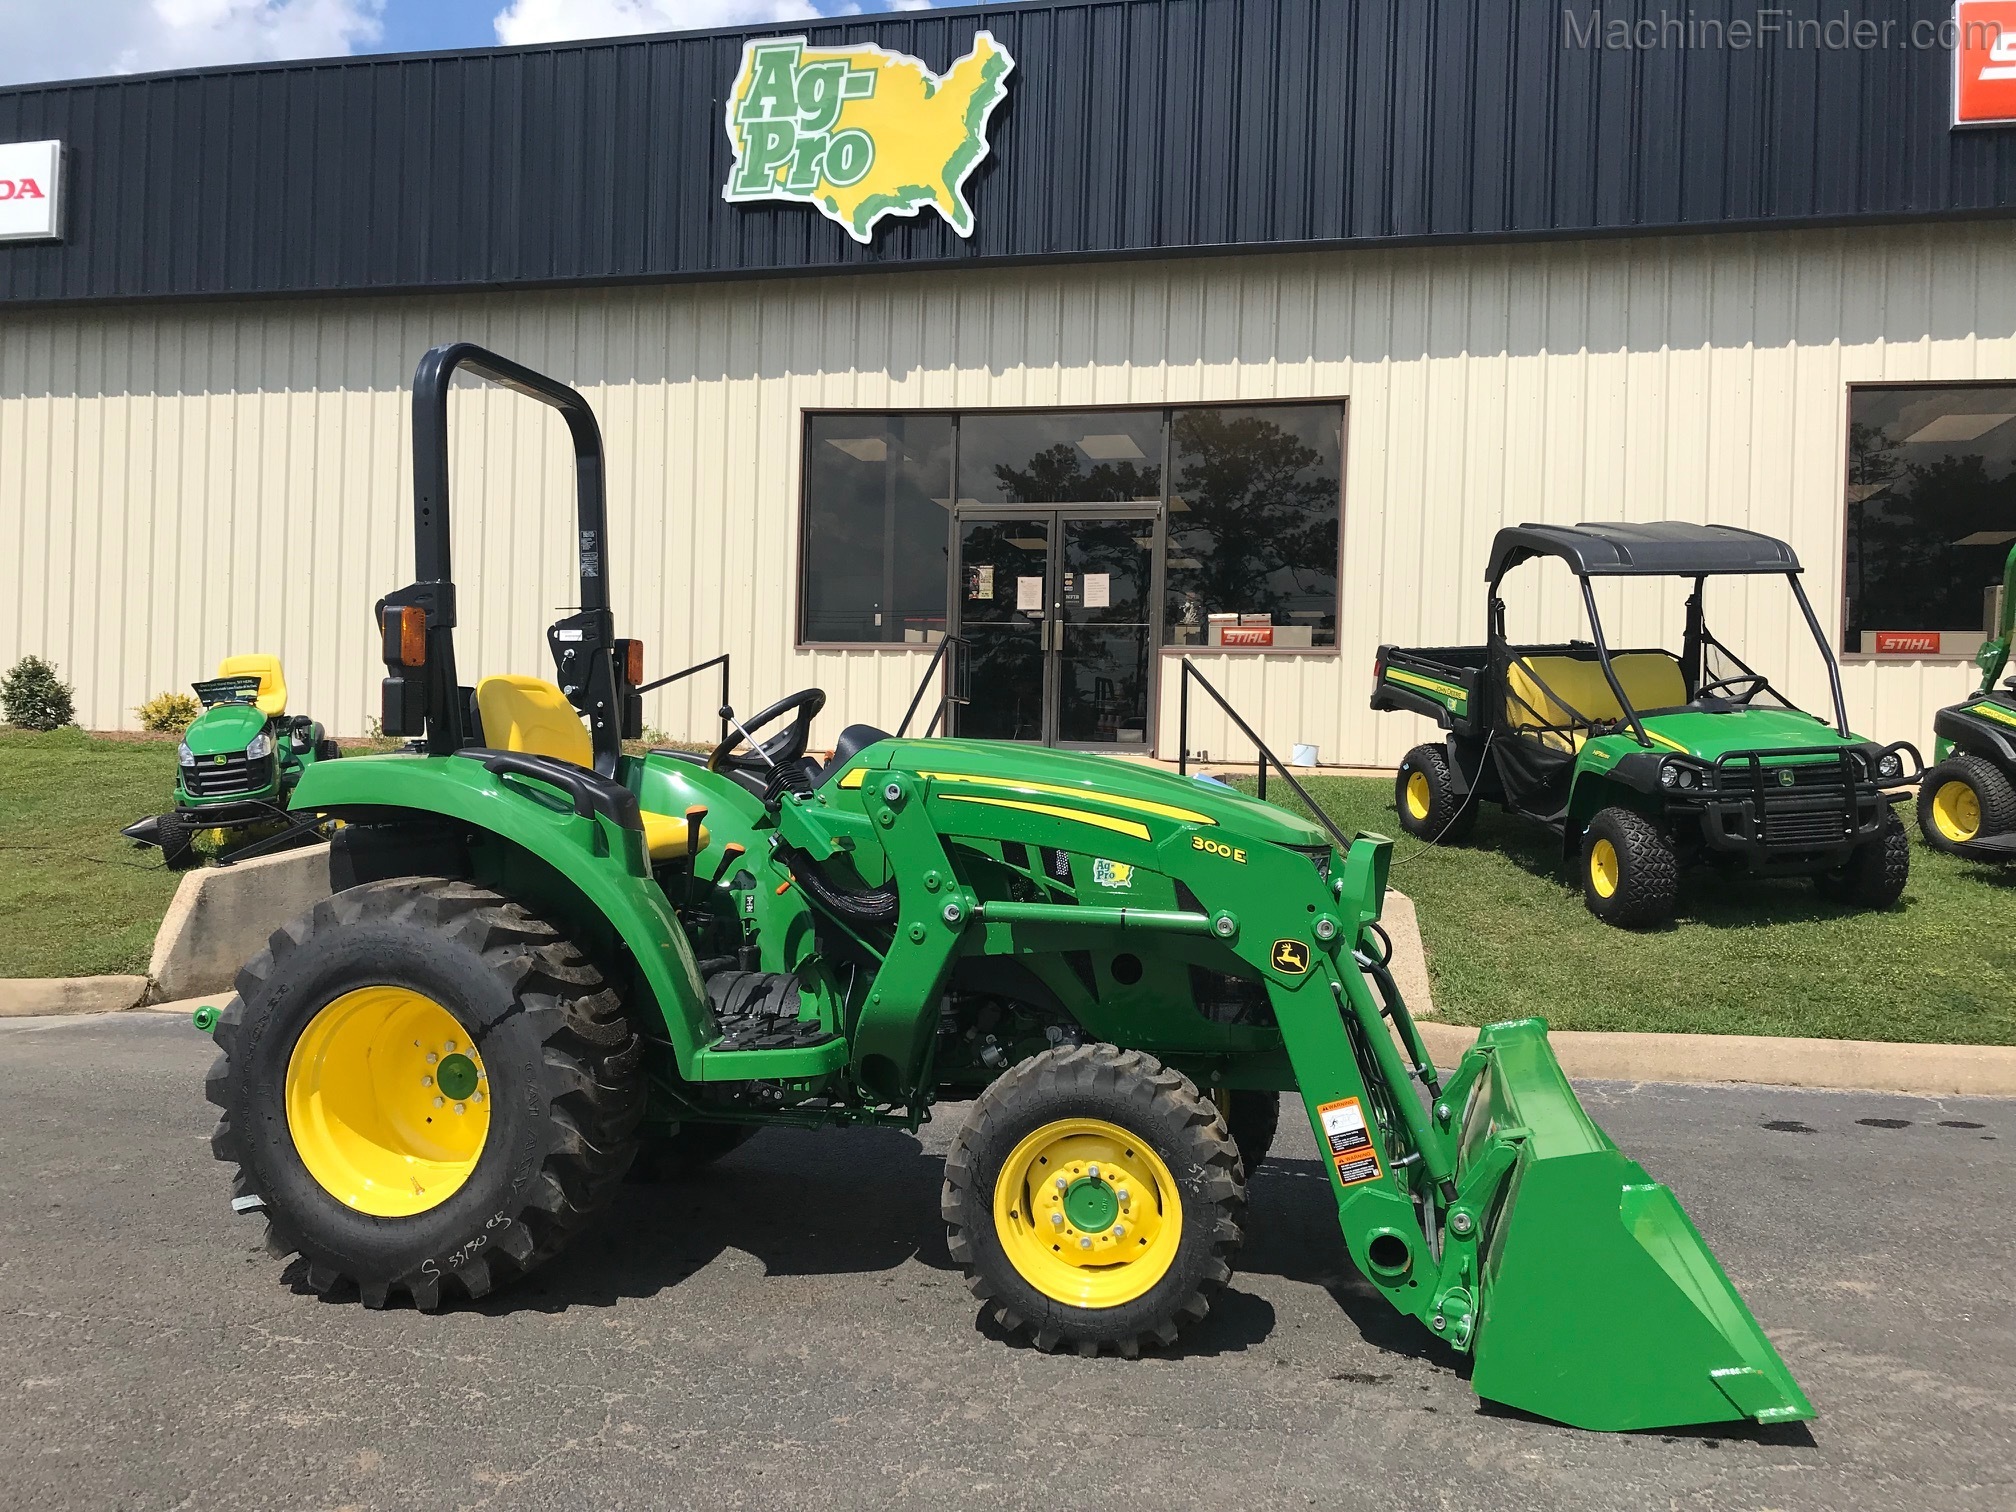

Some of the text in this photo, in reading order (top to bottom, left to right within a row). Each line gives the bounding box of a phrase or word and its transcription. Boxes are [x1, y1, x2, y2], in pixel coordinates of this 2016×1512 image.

[735, 43, 877, 134] Ag-
[733, 120, 875, 194] Pro
[1225, 632, 1267, 643] STIHL
[1882, 638, 1934, 650] STIHL
[1097, 871, 1115, 879] Pro
[1328, 1099, 1354, 1110] WARNING
[1345, 1151, 1371, 1161] WARNING
